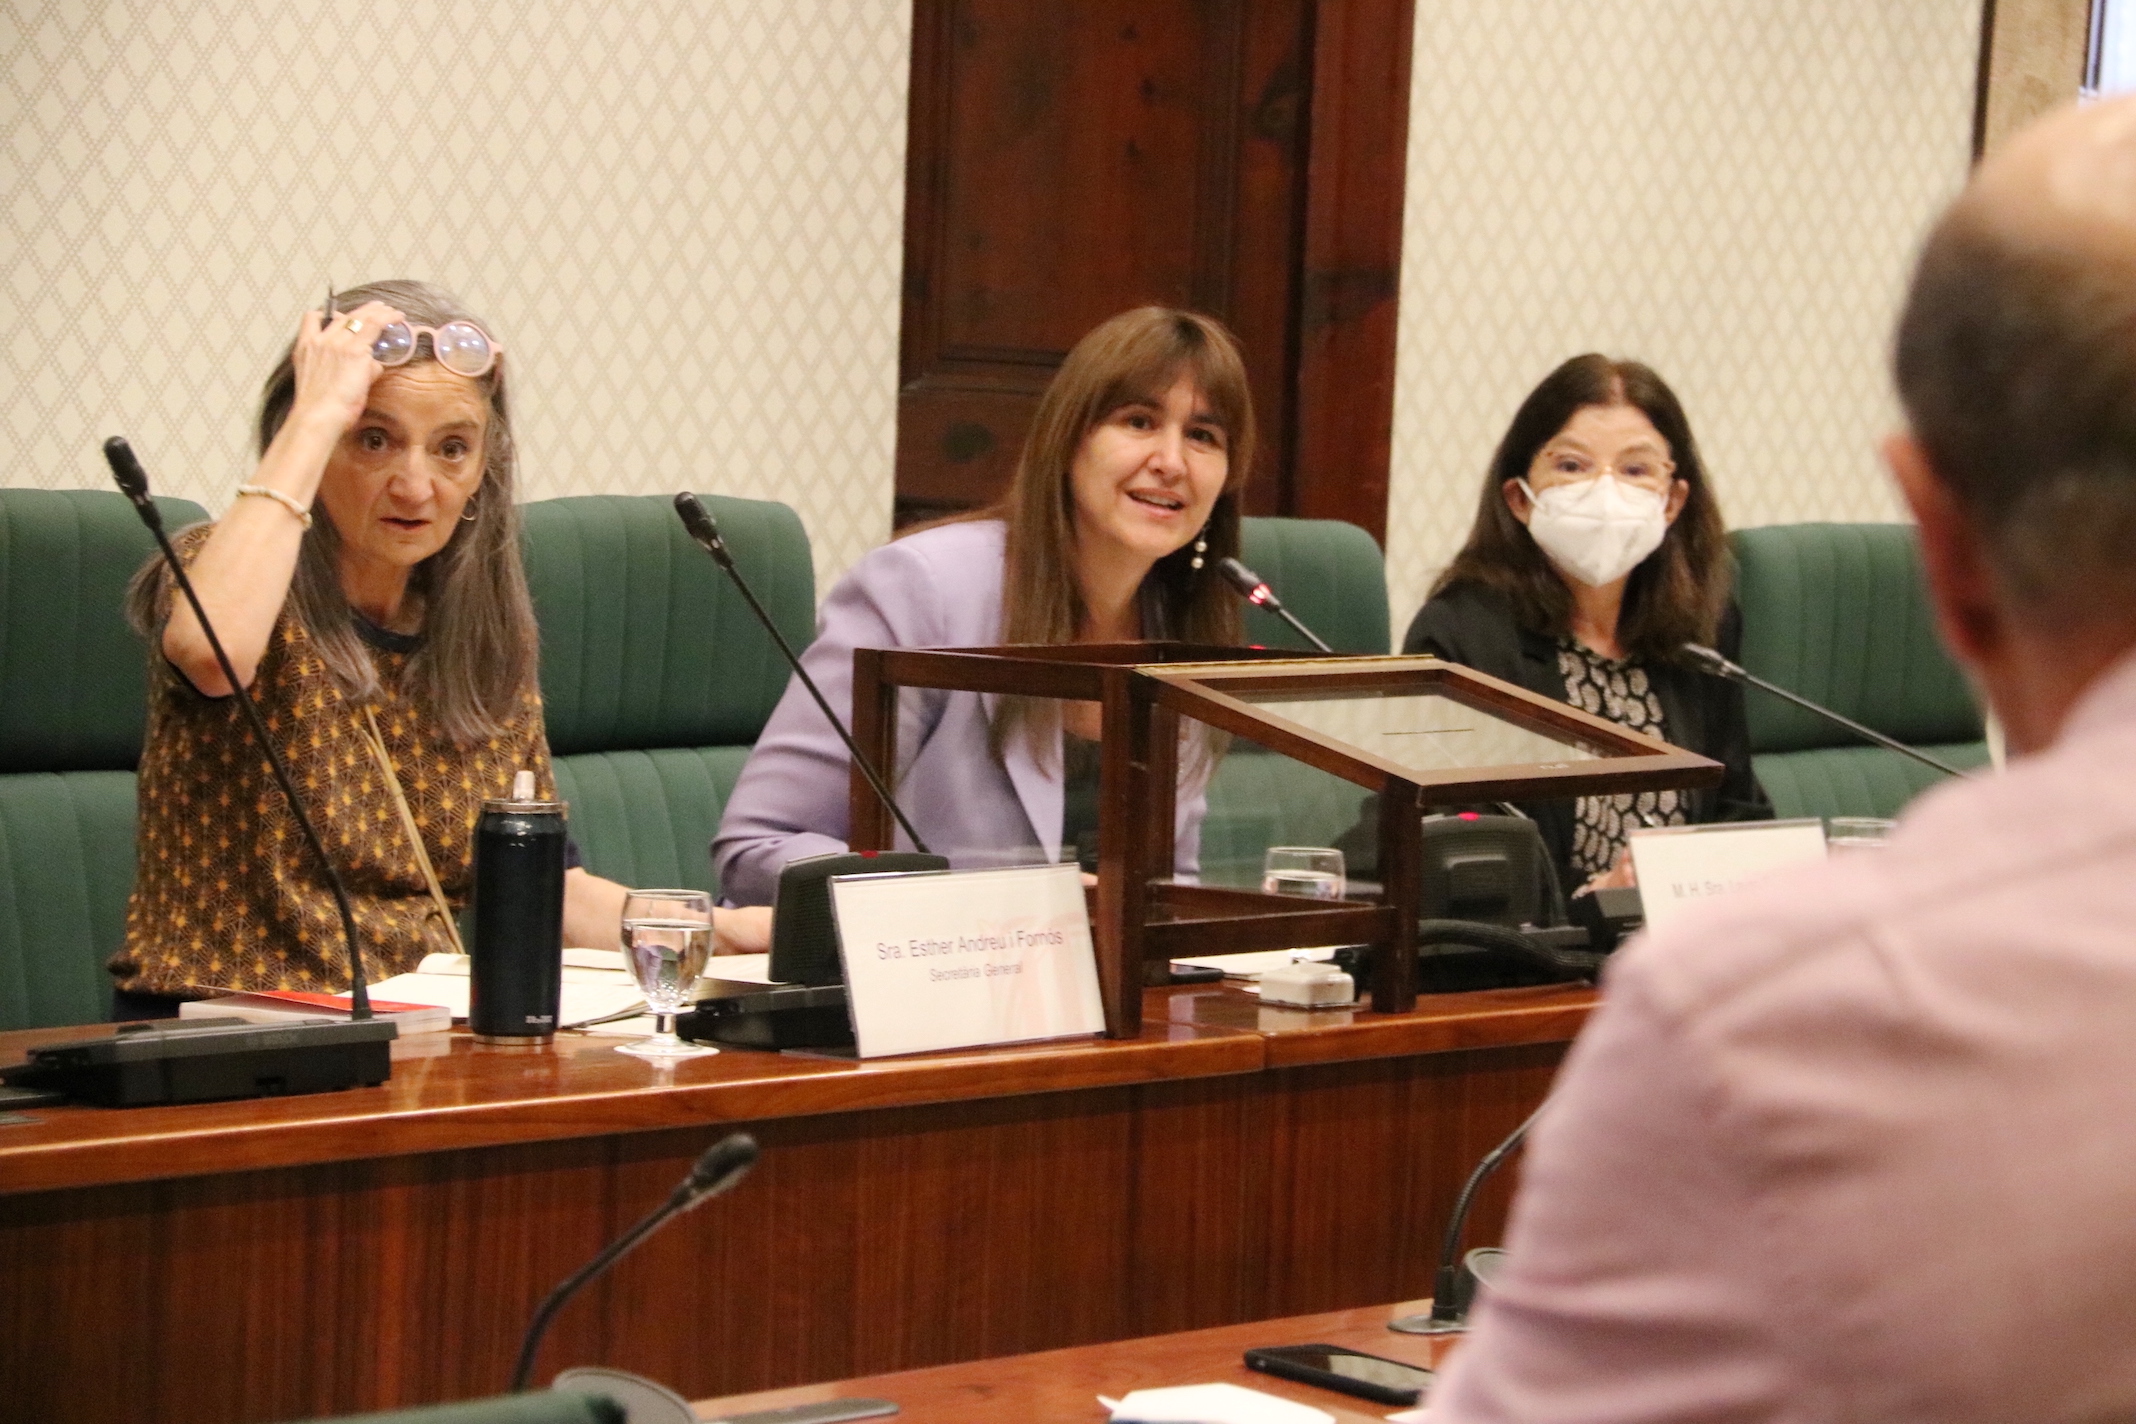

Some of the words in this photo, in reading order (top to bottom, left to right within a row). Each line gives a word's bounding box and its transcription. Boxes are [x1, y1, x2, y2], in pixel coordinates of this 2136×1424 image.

[876, 942, 906, 960] Sra.
[908, 939, 954, 958] Esther
[958, 934, 1007, 954] Andreu
[1008, 931, 1014, 948] i
[1015, 927, 1064, 948] Fornós
[984, 961, 1024, 977] General
